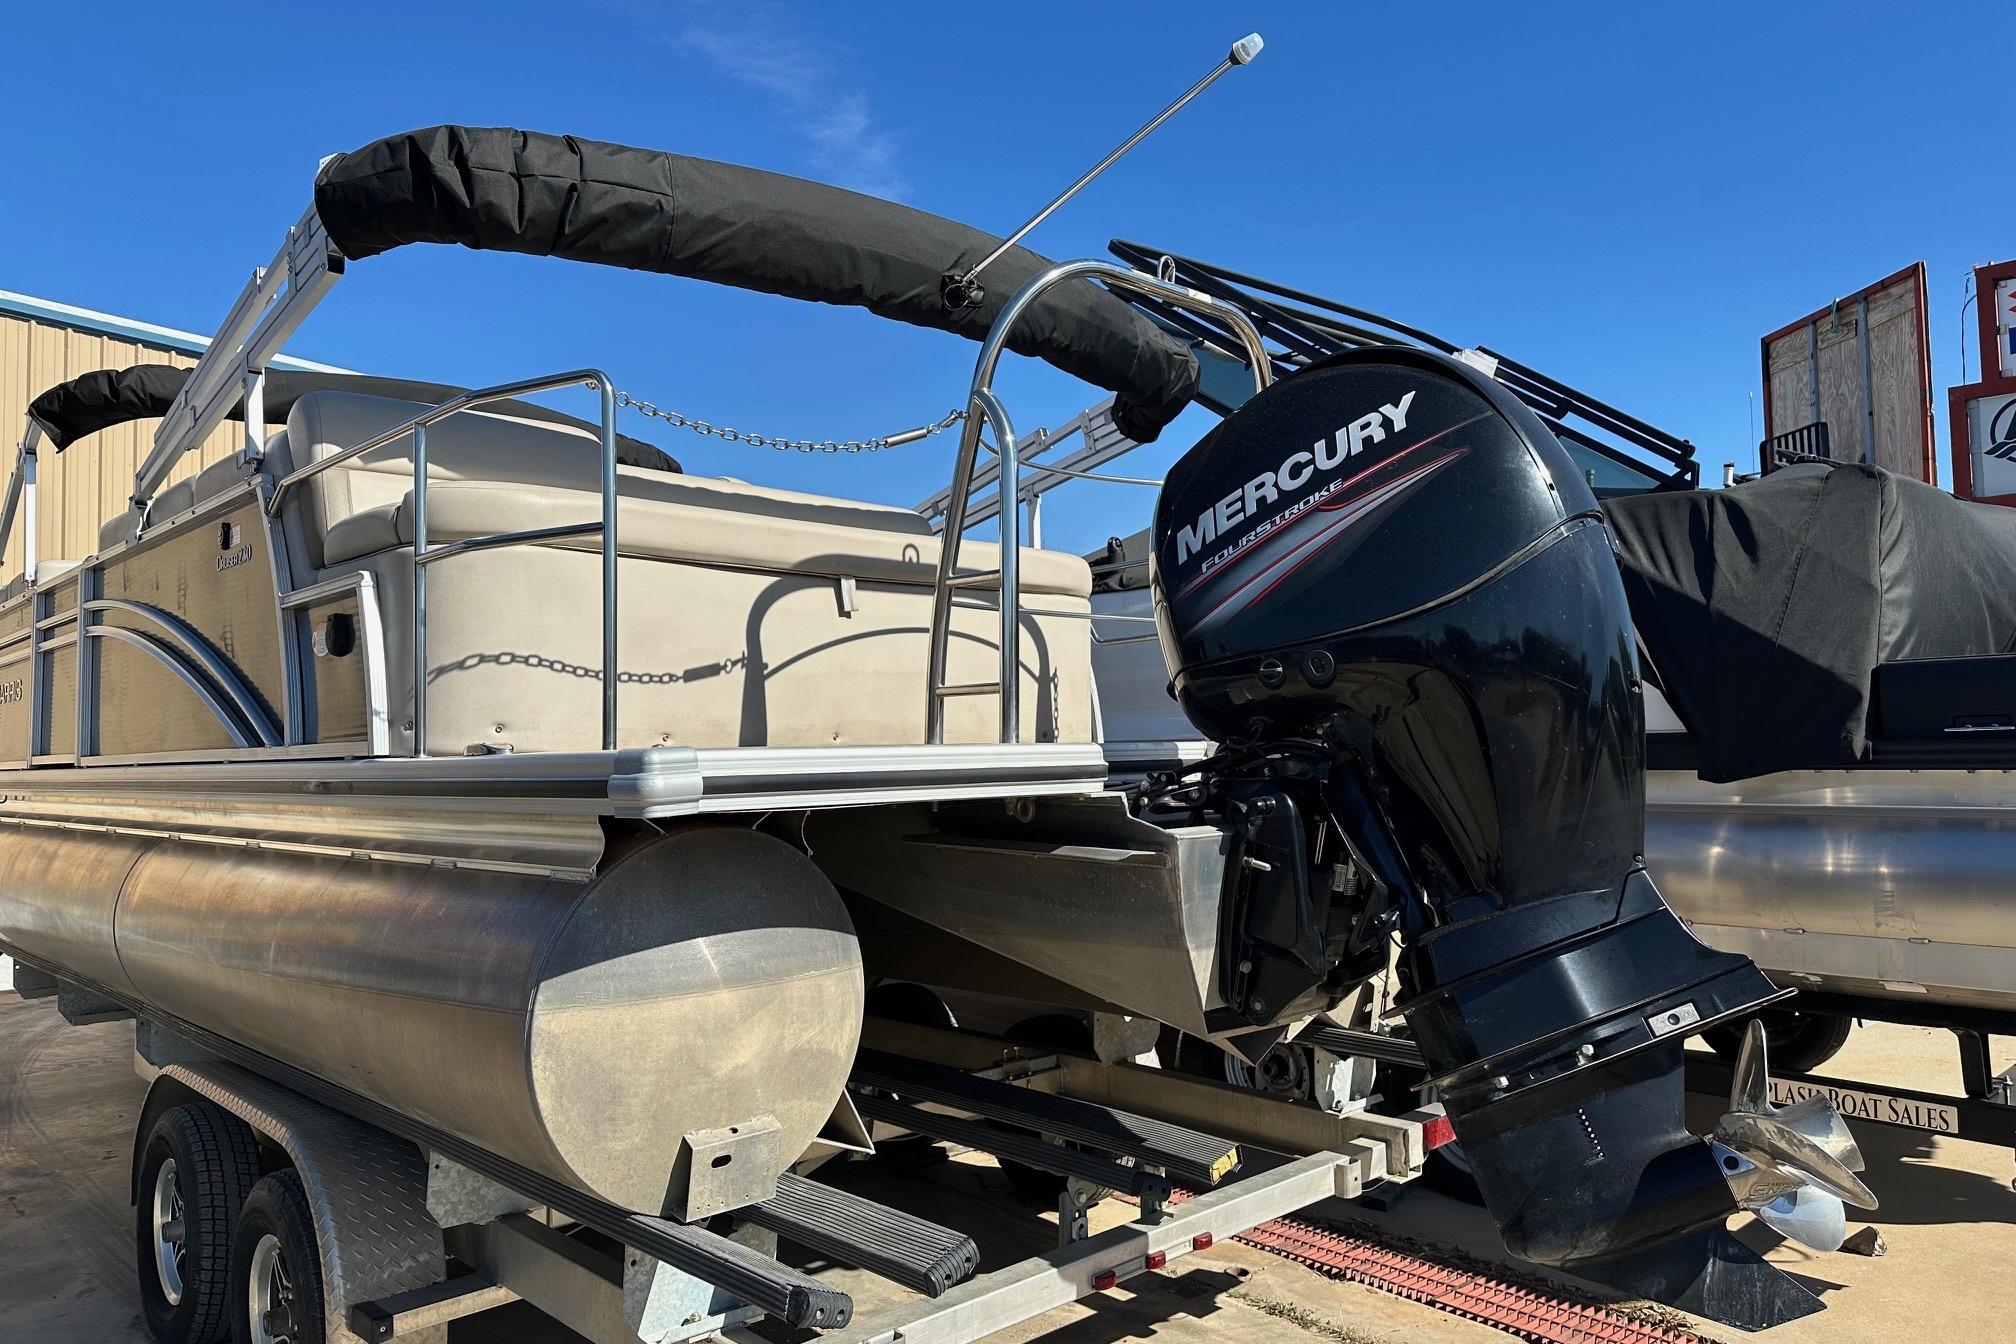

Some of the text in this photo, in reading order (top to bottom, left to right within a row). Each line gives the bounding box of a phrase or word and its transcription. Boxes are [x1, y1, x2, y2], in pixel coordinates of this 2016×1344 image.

[1177, 390, 1416, 566] MERCURY
[1201, 478, 1344, 574] FOURSTROKE
[1828, 1089, 1882, 1119] BOAT
[1888, 1098, 1950, 1131] SALES
